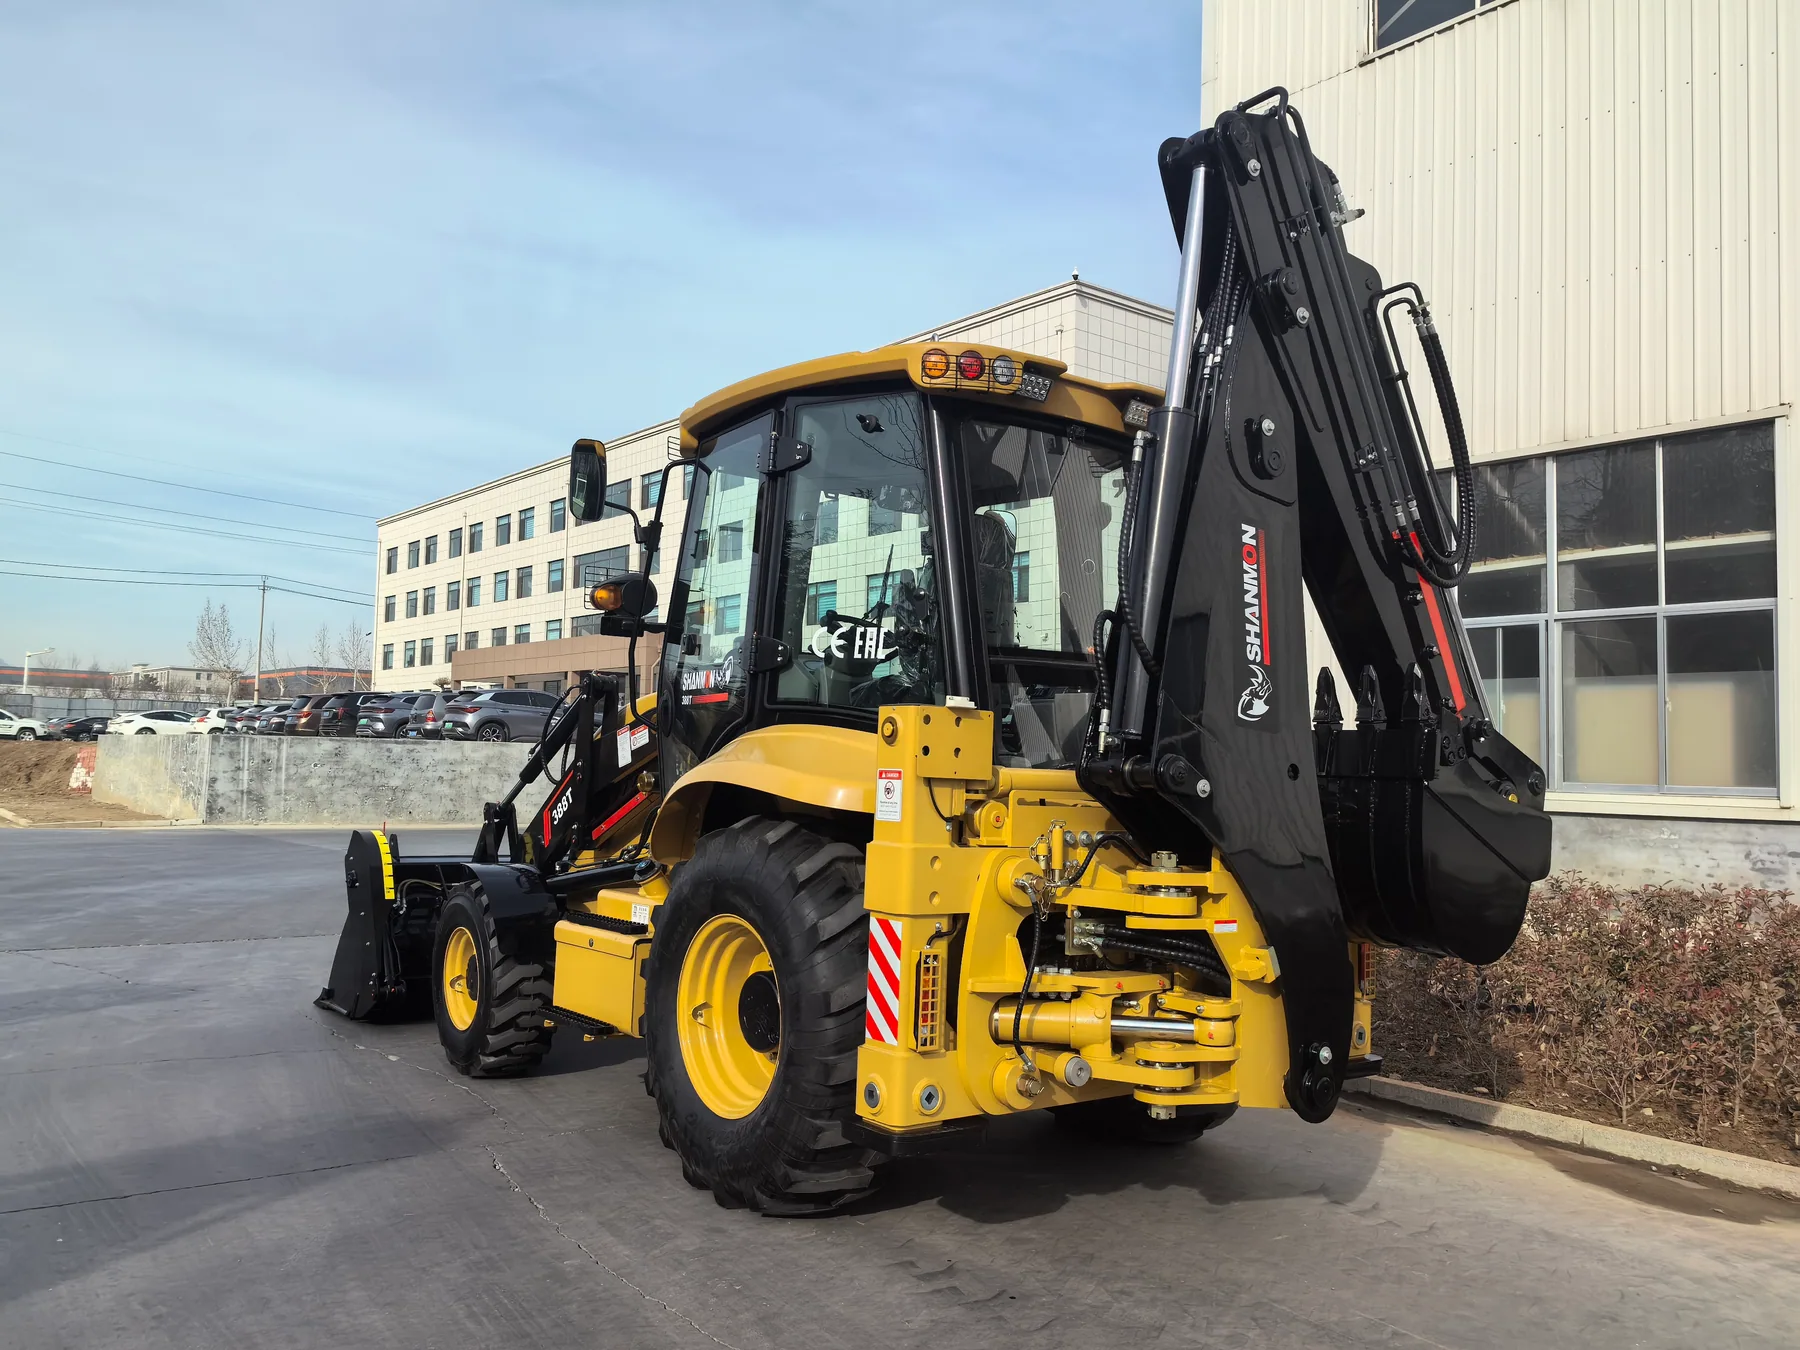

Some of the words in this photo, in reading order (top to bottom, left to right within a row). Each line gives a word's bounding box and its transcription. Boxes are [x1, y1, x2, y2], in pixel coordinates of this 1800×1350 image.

[1241, 523, 1262, 663] SHANMON
[811, 626, 848, 659] CE
[682, 669, 716, 691] SHANMON
[551, 786, 573, 825] 388T
